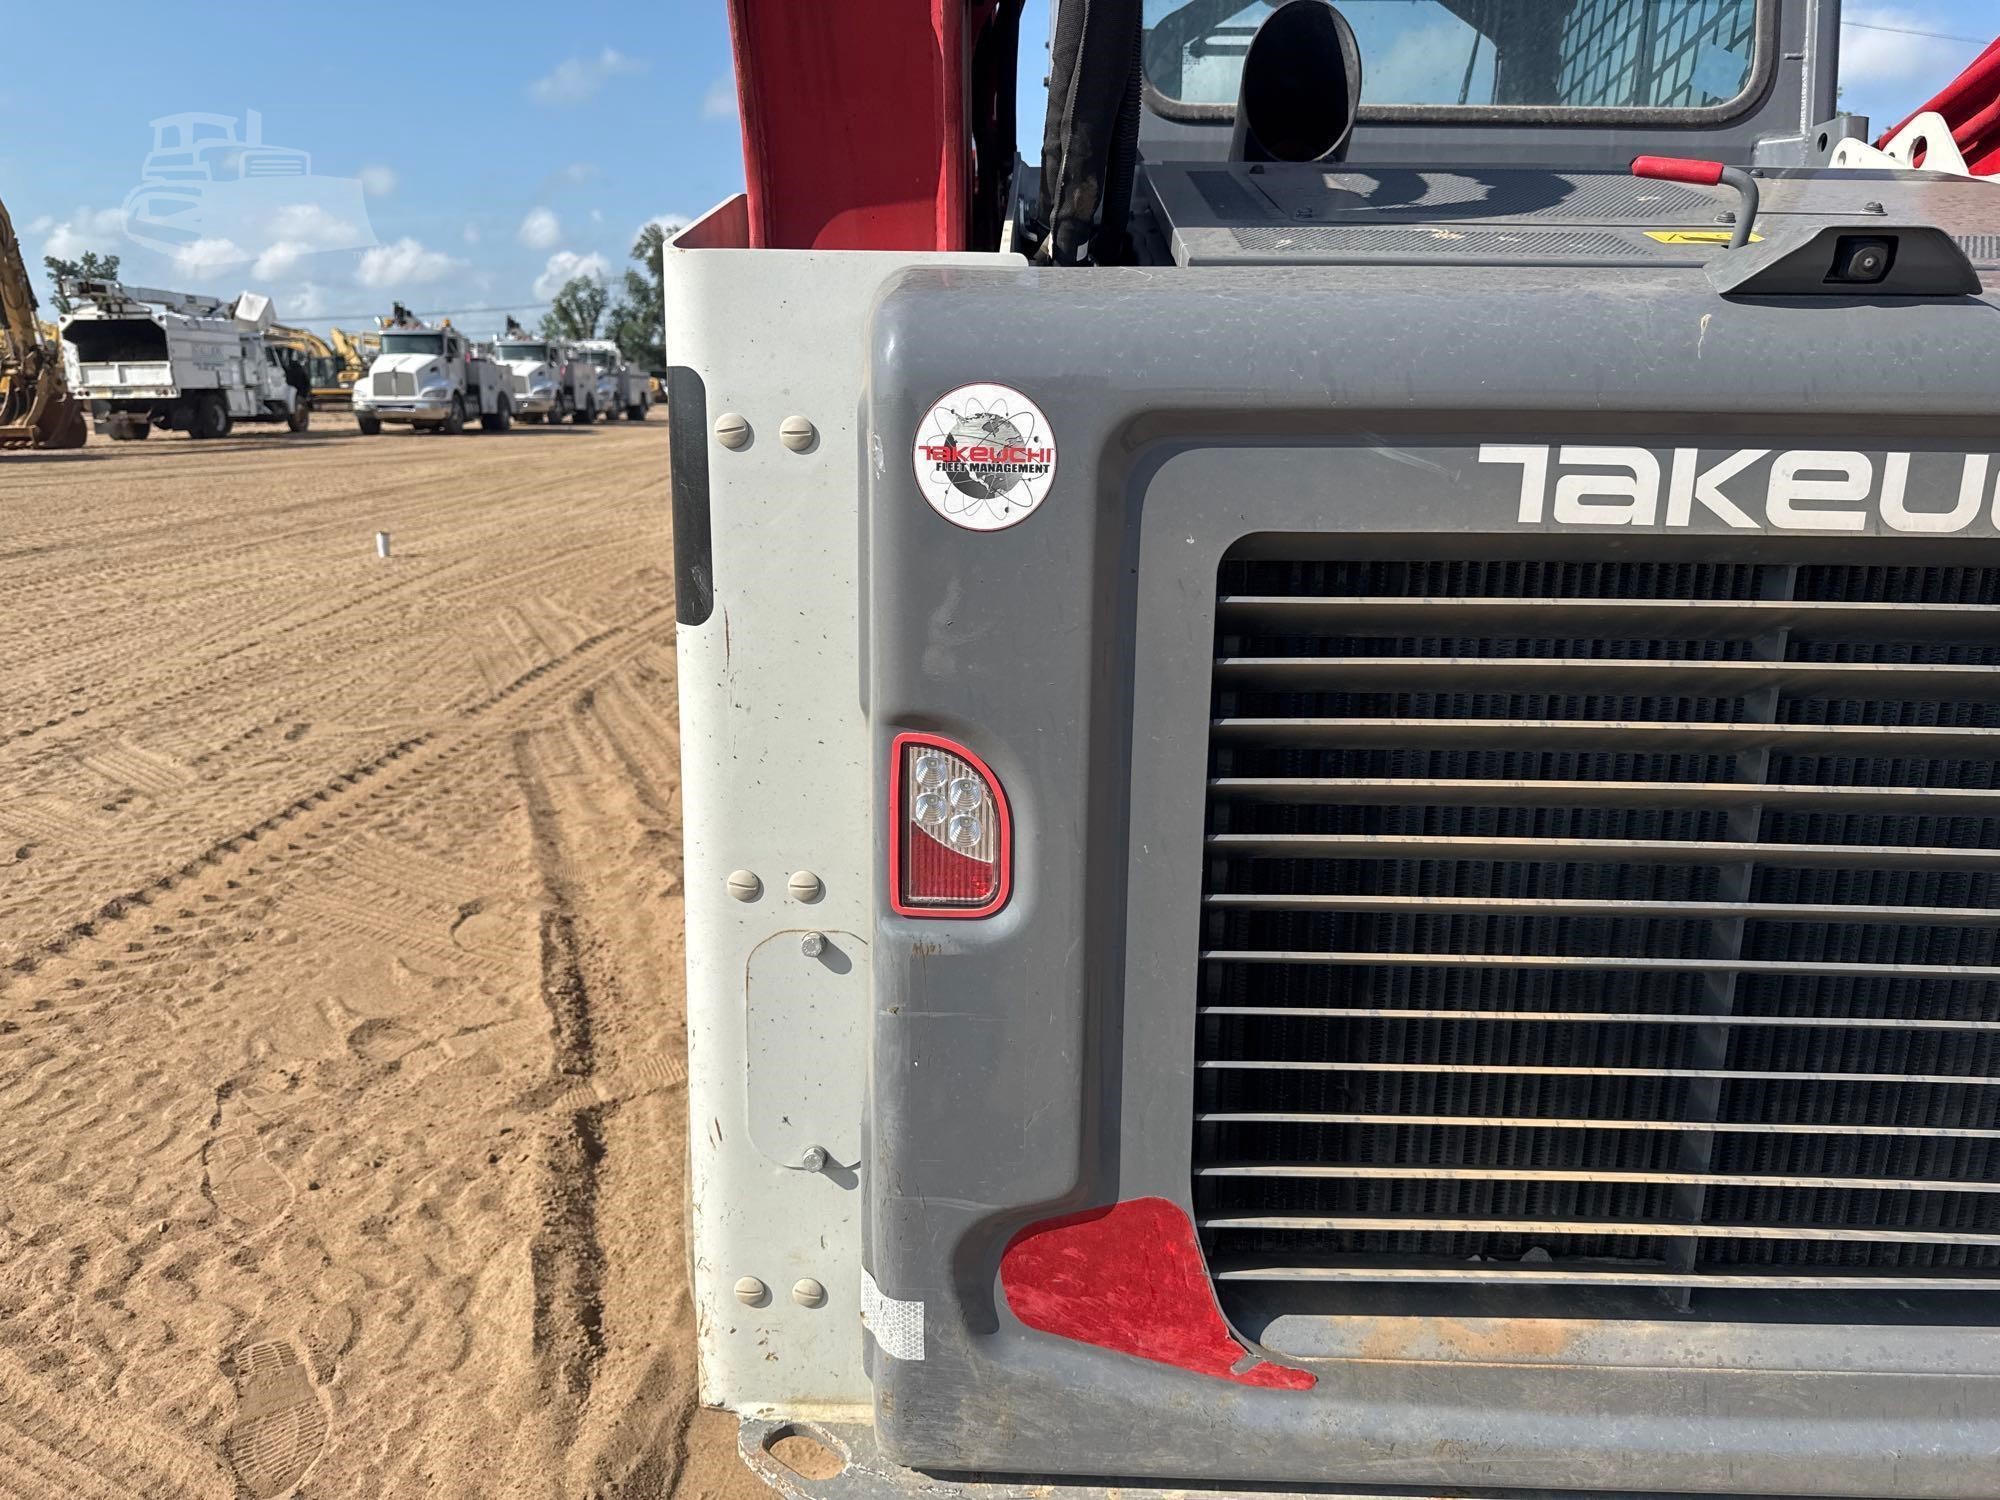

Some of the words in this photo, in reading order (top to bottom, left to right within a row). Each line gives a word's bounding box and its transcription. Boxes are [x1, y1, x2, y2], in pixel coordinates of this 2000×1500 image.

[936, 462, 967, 472] FLEET
[969, 462, 1051, 474] MANAGEMENT
[1478, 443, 2000, 533] TaKeU
